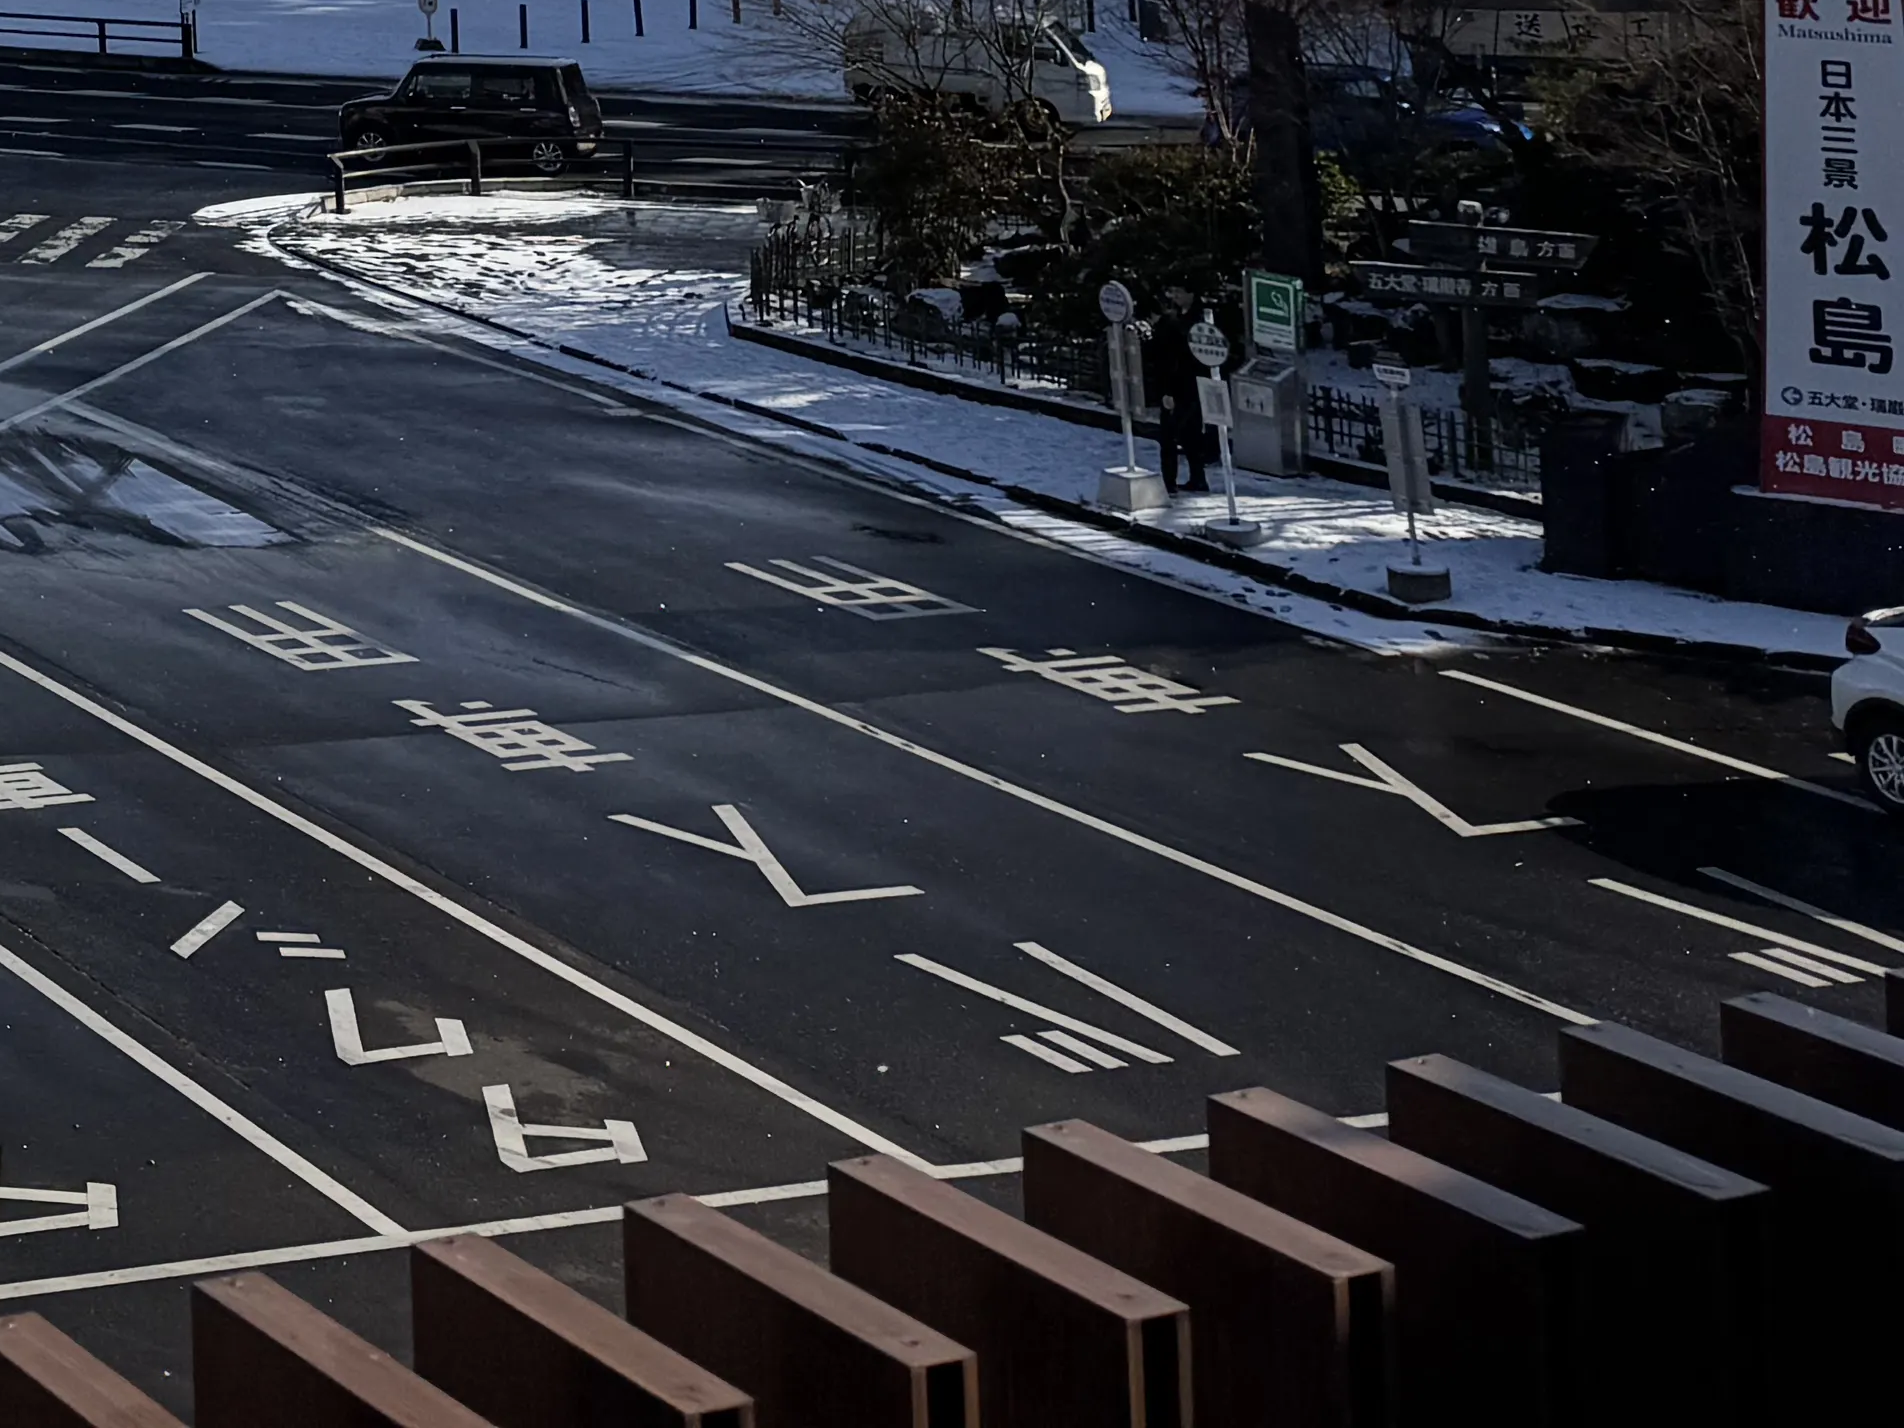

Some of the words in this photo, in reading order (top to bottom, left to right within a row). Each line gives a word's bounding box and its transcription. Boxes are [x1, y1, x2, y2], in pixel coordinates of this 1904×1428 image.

[1778, 23, 1892, 44] Matsushima
[1819, 59, 1858, 190] 日本三景
[1799, 201, 1893, 375] 松島
